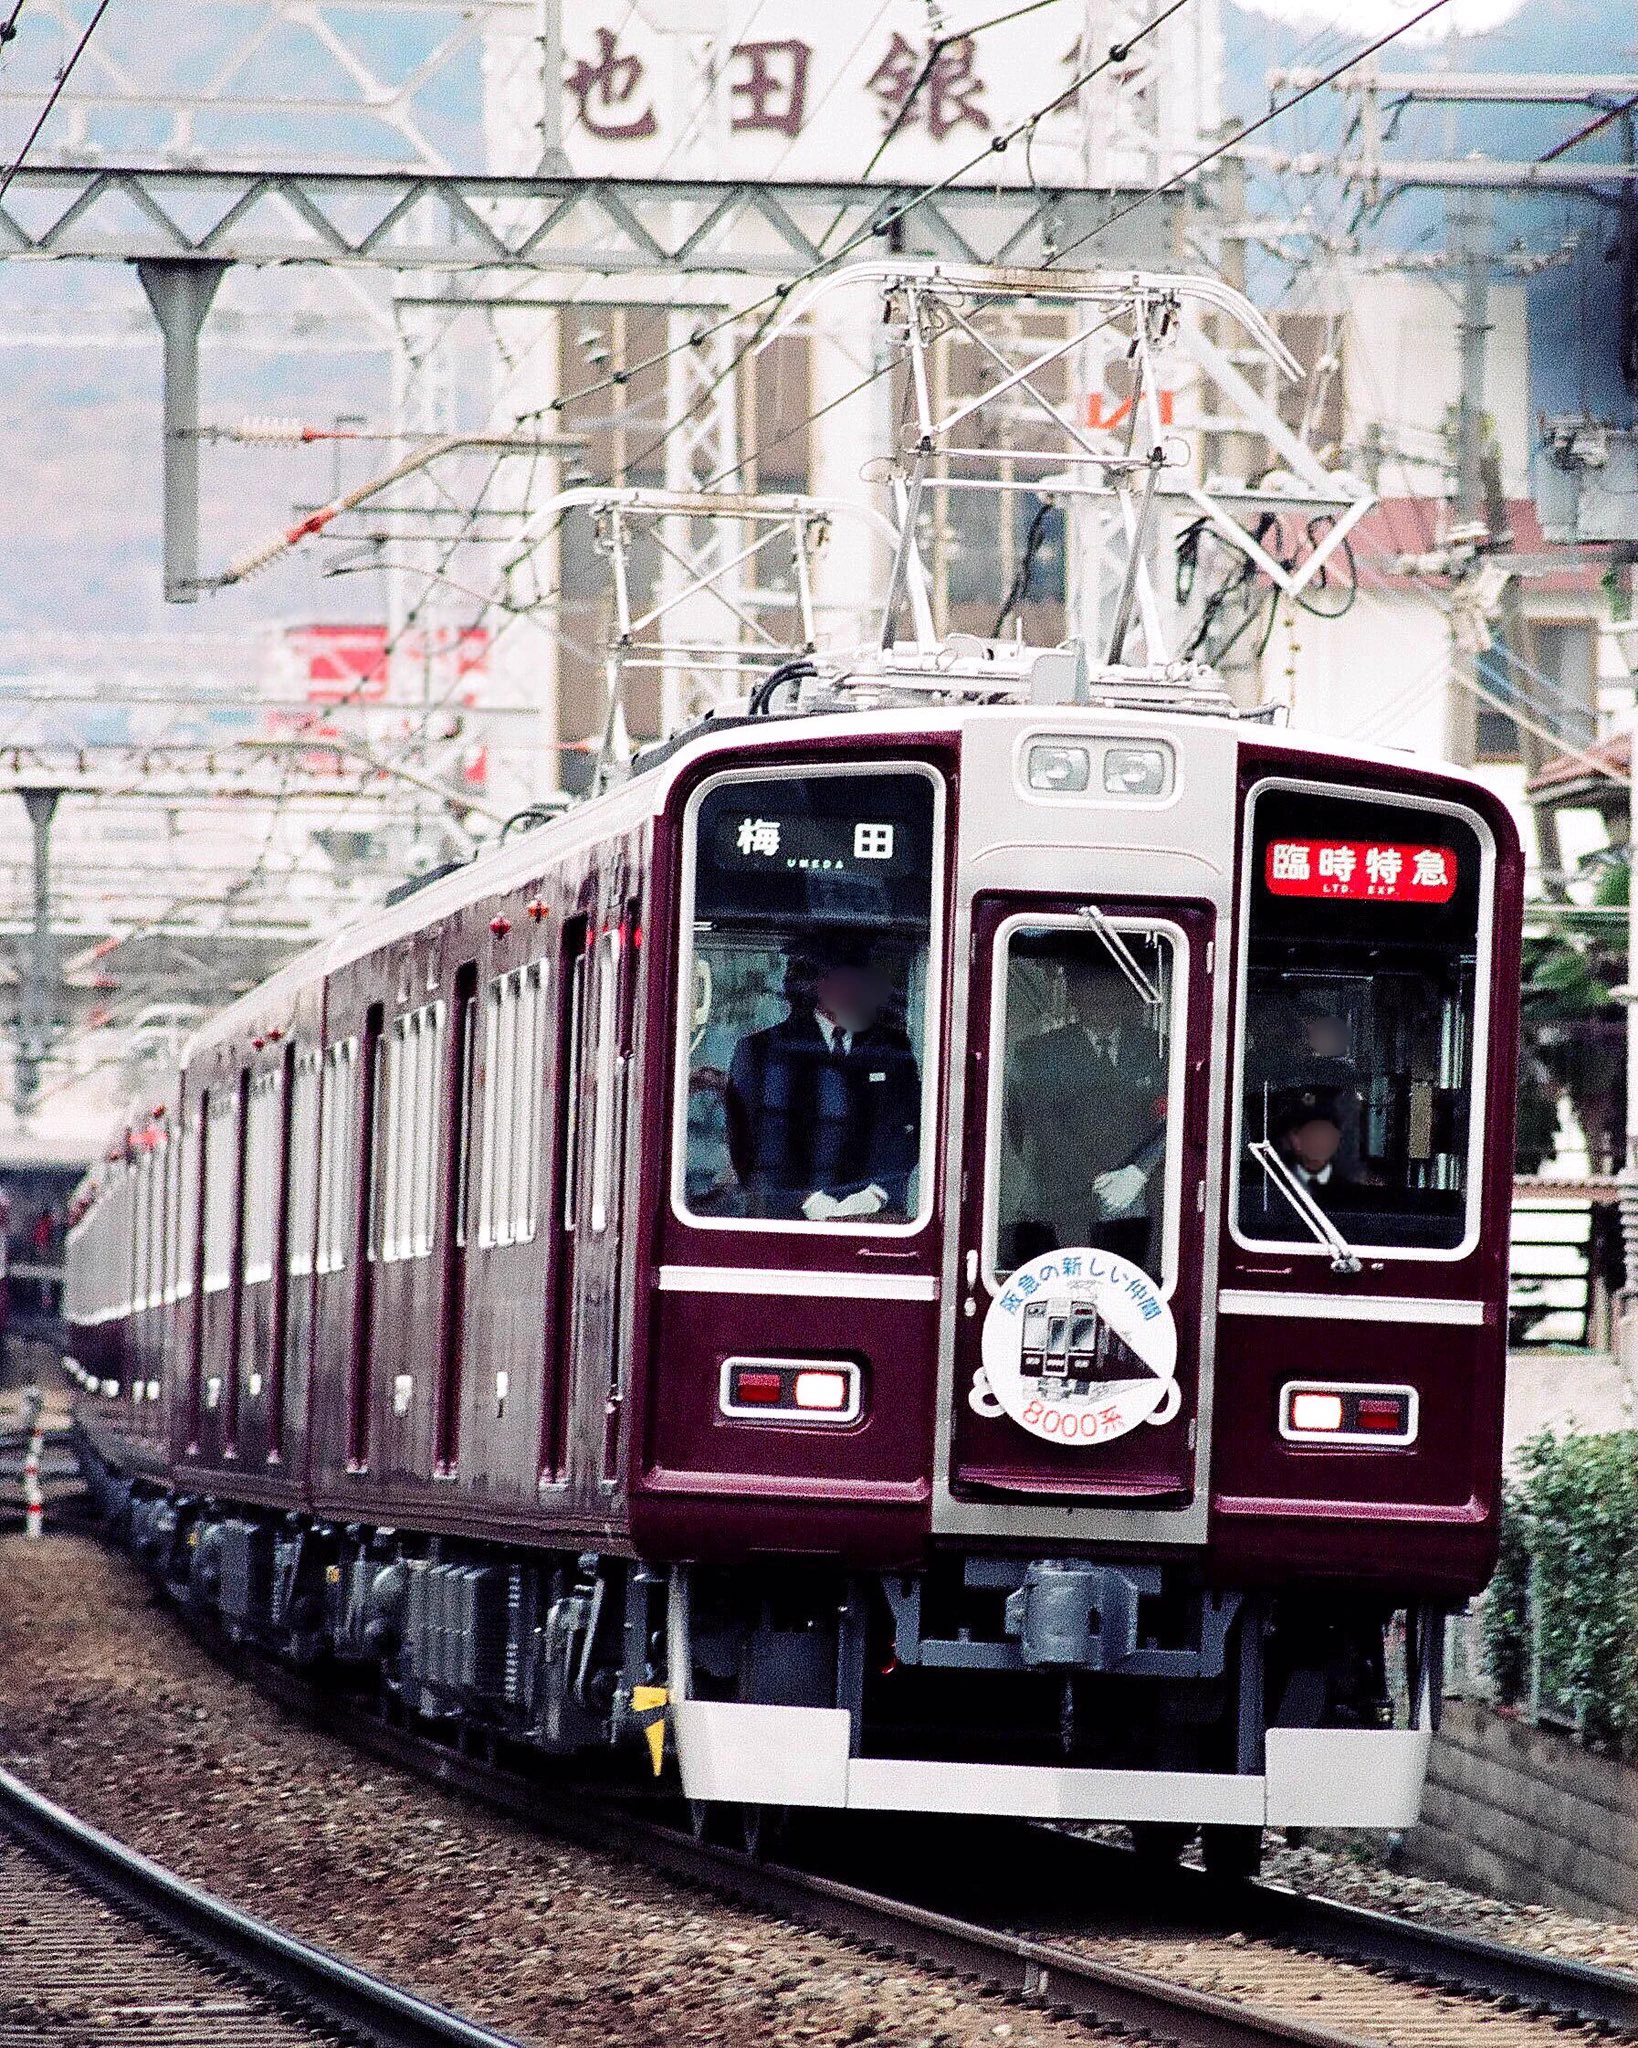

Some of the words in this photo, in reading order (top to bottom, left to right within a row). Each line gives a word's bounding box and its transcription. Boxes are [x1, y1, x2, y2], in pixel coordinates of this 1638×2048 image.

[736, 818, 894, 859] 梅田
[786, 858, 845, 870] UMEDA
[1272, 843, 1449, 887] 臨時特急
[1000, 1255, 1162, 1322] 阪急の新しい仲間
[1022, 1399, 1126, 1438] 8000系
